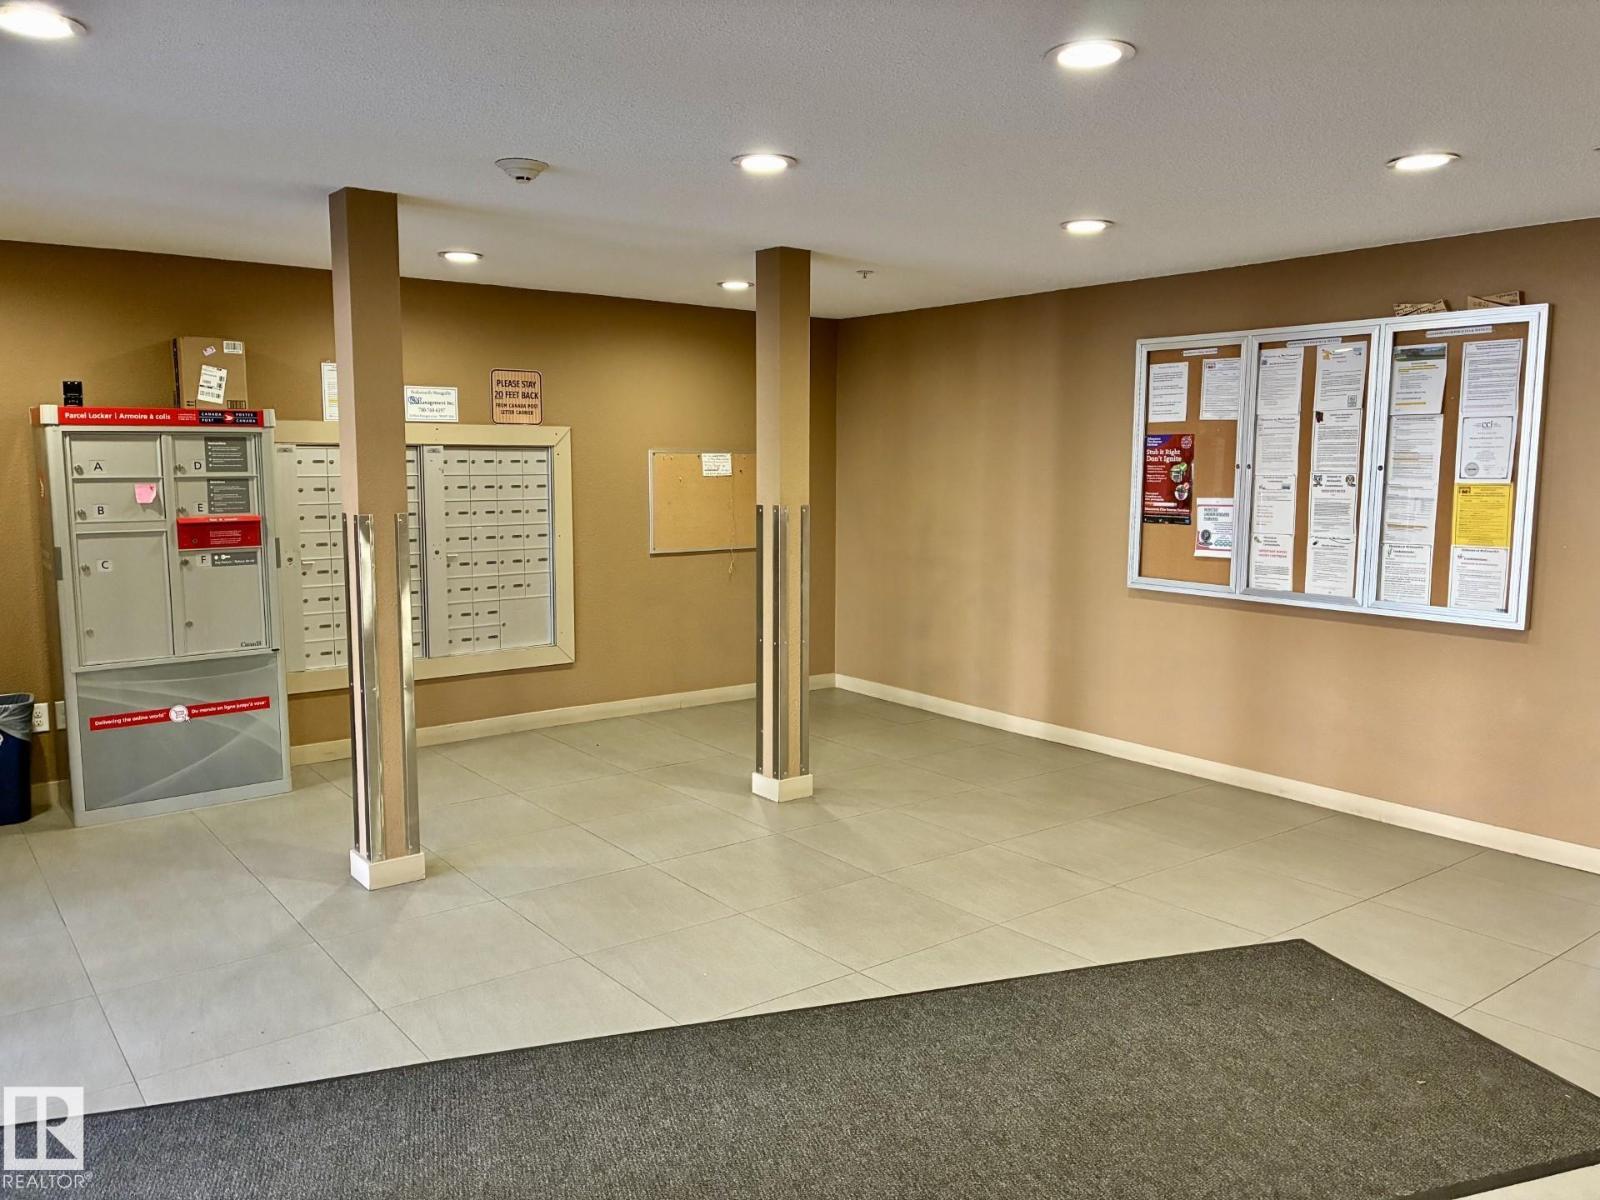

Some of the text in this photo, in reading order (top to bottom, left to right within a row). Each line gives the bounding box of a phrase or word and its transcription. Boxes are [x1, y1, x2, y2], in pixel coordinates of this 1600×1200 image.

[496, 379, 537, 389] PLEASE STAY
[494, 390, 539, 400] 20 FEET BACK
[64, 411, 87, 420] Parcel
[88, 412, 112, 420] Locker
[1165, 448, 1181, 456] Right
[93, 462, 103, 471] A
[194, 461, 202, 471] D
[97, 506, 105, 515] B
[197, 503, 204, 512] E
[201, 555, 207, 564] F
[101, 560, 109, 570] C
[94, 717, 122, 727] Delivering
